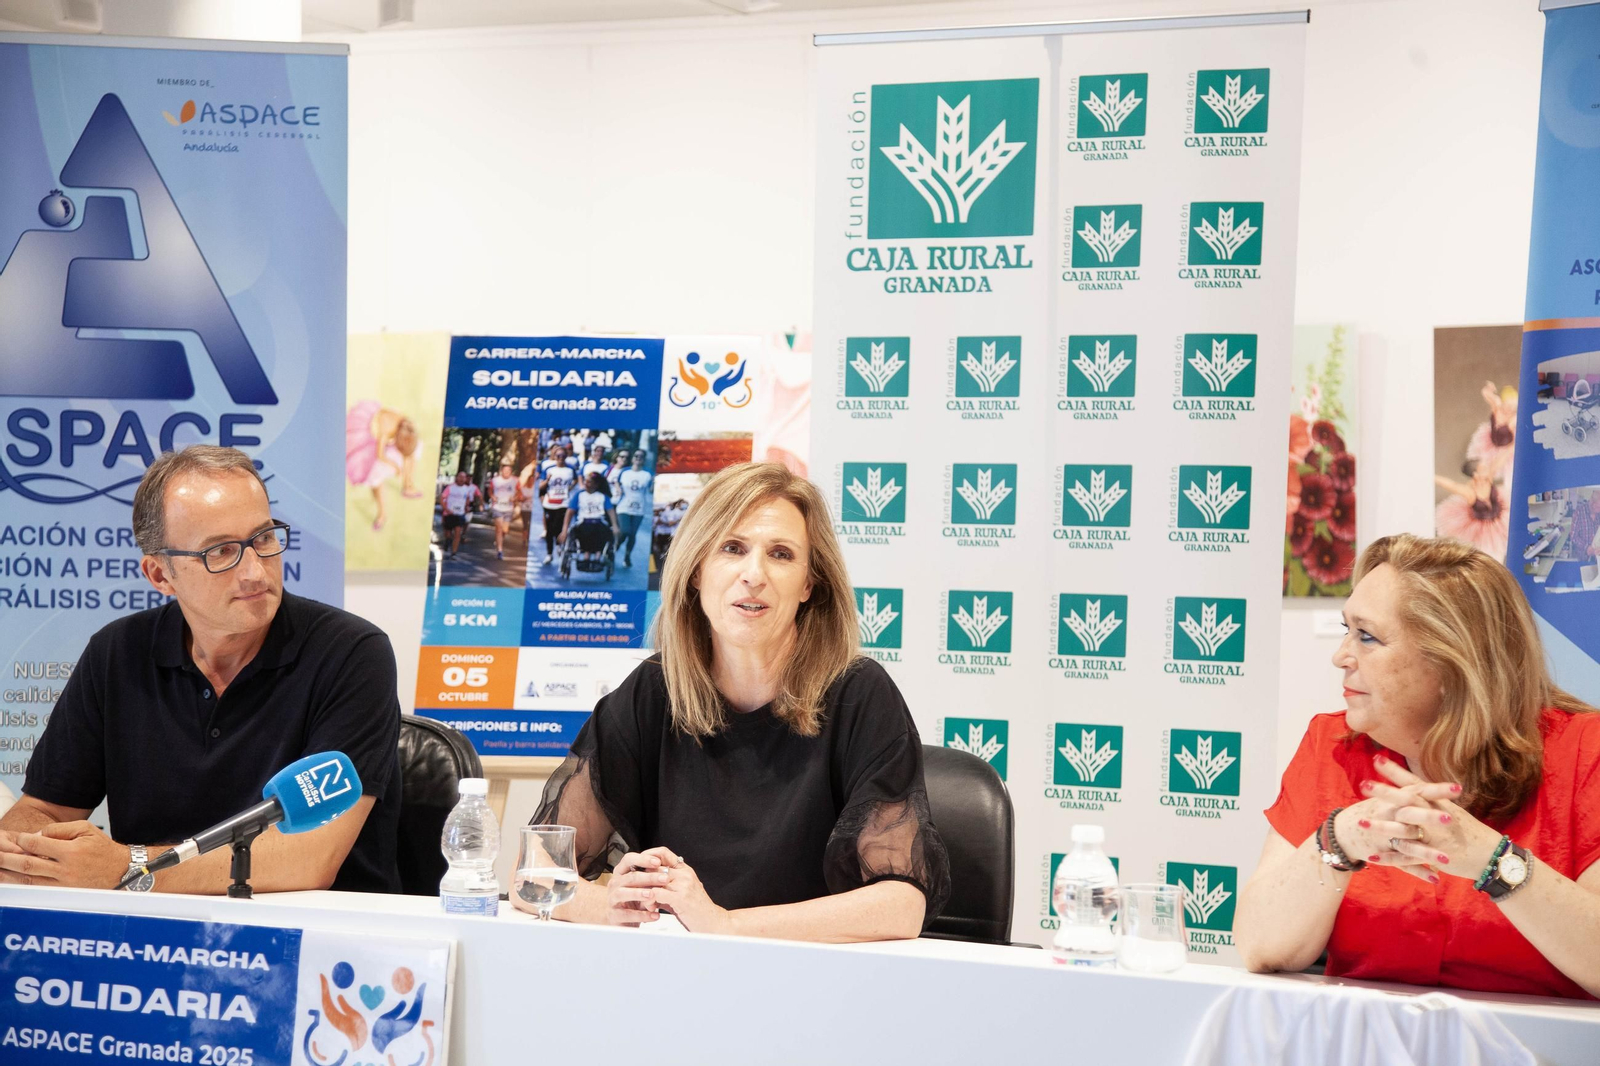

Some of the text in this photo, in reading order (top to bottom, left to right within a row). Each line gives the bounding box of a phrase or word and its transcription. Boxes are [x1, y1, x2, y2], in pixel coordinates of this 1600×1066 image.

[157, 78, 196, 86] MIEMBRO
[1184, 72, 1195, 135] fundación
[200, 102, 320, 128] ASPACE
[184, 142, 239, 152] Andalucía
[1067, 140, 1146, 152] CAJA RURAL
[1184, 136, 1267, 148] CAJA RURAL
[1083, 152, 1128, 161] GRANADA
[1201, 149, 1249, 157] GRANADA
[845, 91, 866, 240] fundación
[847, 245, 1033, 272] CAJA RURAL
[1062, 270, 1140, 282] CAJA RURAL
[1178, 268, 1261, 279] CAJA RURAL
[884, 276, 992, 293] GRANADA
[1194, 280, 1243, 289] GRANADA
[464, 348, 646, 360] CARRERA-MARCHA
[472, 370, 638, 387] SOLIDARIA
[464, 396, 636, 410] ASPACE Granada 2025
[836, 400, 909, 411] CAJA RURAL
[946, 401, 1020, 411] CAJA RURAL
[1057, 400, 1135, 411] CAJA RURAL
[1173, 400, 1255, 411] CAJA RURAL
[851, 411, 893, 419] GRANADA
[961, 412, 1004, 420] GRANADA
[1073, 412, 1119, 420] GRANADA
[1189, 412, 1236, 420] GRANADA
[834, 526, 906, 536] CAJA RURAL
[942, 527, 1016, 538] CAJA RURAL
[1053, 529, 1131, 541] CAJA RURAL
[94, 527, 139, 548] GR
[847, 537, 890, 545] GRANADA
[1168, 531, 1250, 543] CAJA RURAL
[957, 539, 1000, 547] GRANADA
[1069, 541, 1114, 550] GRANADA
[1184, 544, 1232, 553] GRANADA
[0, 552, 143, 579] IÓN A PER
[451, 598, 483, 607] OPCIÓN
[538, 602, 628, 612] SEDE ASPACE
[443, 614, 498, 627] 5 KM
[548, 611, 616, 620] GRANADA
[441, 654, 494, 664] DOMINGO
[938, 654, 1012, 667] CAJA RURAL
[14, 661, 75, 680] NUES
[1048, 659, 1126, 671] CAJA RURAL
[1164, 663, 1245, 677] CAJA RURAL
[953, 667, 995, 675] GRANADA
[1064, 671, 1109, 680] GRANADA
[443, 667, 488, 687] 05
[1179, 676, 1226, 685] GRANADA
[438, 692, 489, 702] OCTUBRE
[520, 722, 528, 732] E
[530, 722, 562, 733] INFO:
[294, 774, 315, 807] NOTICIAS
[1044, 788, 1122, 803] CAJA RURAL
[1060, 801, 1105, 811] GRANADA
[1160, 795, 1240, 810] CAJA RURAL
[1175, 808, 1222, 819] GRANADA
[1040, 919, 1060, 930] CAJ
[1190, 932, 1235, 946] RURAL
[4, 933, 270, 971] CARRERA-MARCHA
[14, 976, 256, 1024] SOLIDARIA
[2, 1026, 254, 1066] ASPACE Granada 2025
